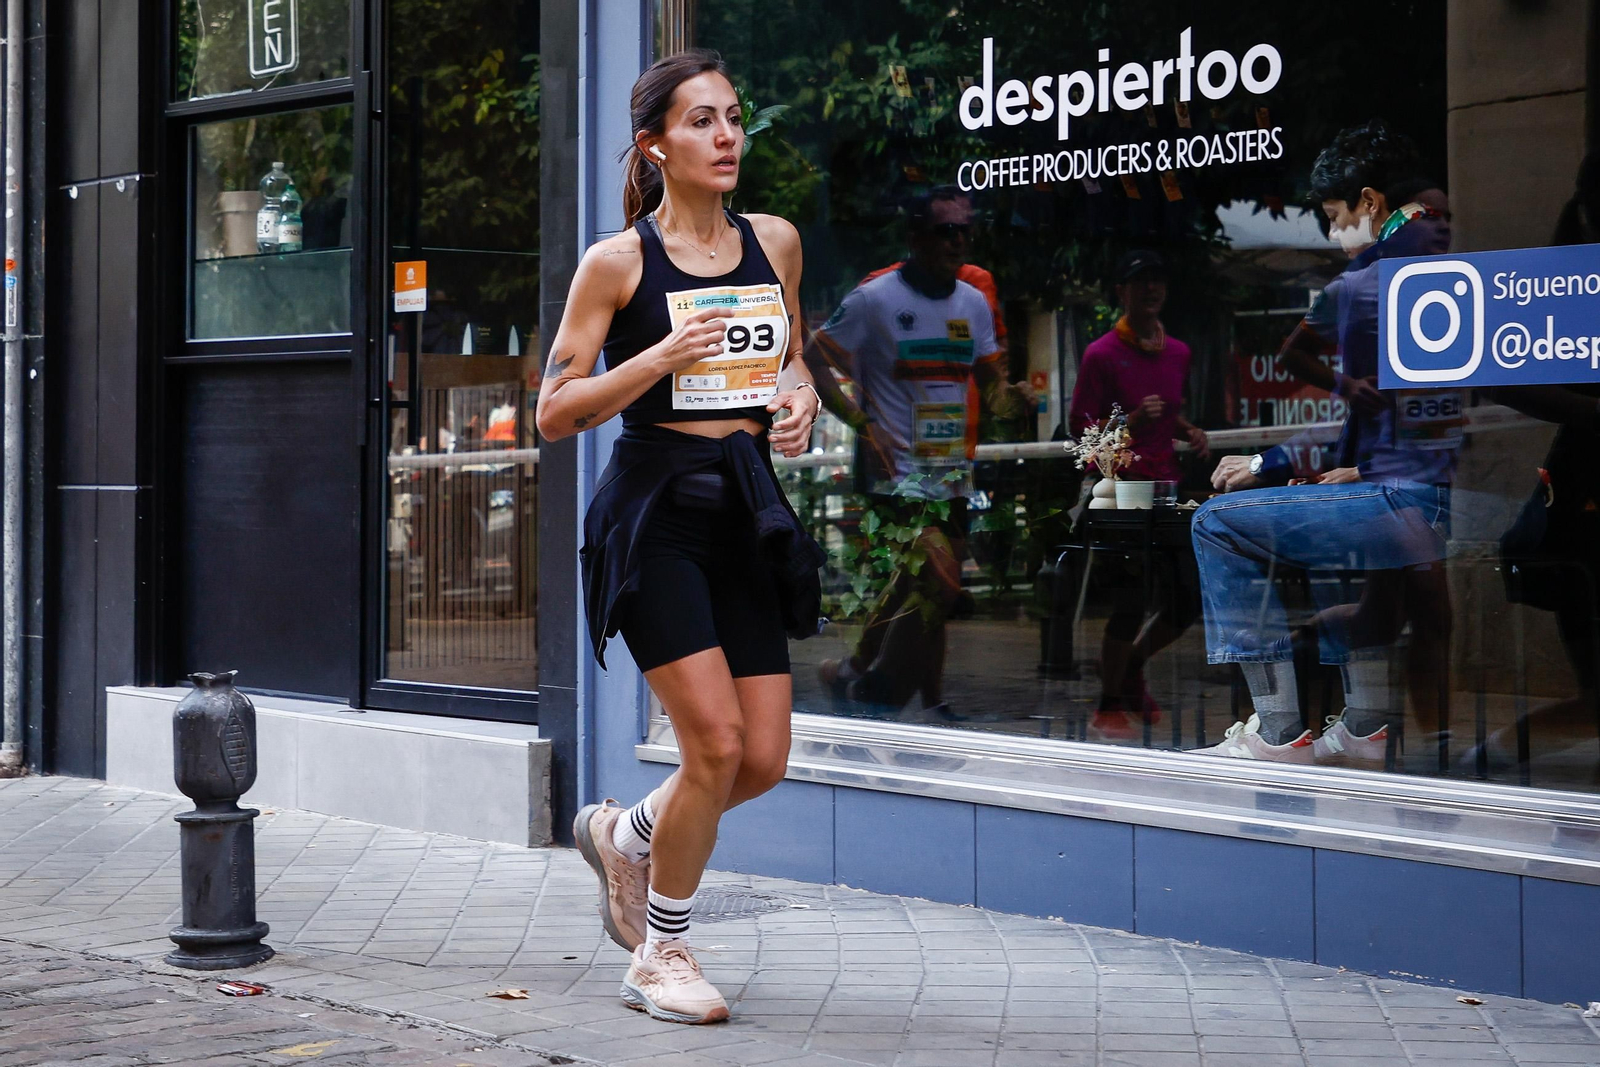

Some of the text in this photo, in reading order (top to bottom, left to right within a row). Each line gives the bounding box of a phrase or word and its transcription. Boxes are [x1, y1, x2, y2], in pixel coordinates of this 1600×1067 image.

[264, 0, 282, 66] EN
[959, 26, 1282, 141] despiertoo
[957, 126, 1284, 192] COFFEE PRODUCERS & ROASTERS
[695, 297, 738, 306] CARRERA
[1493, 271, 1600, 306] Sígueno
